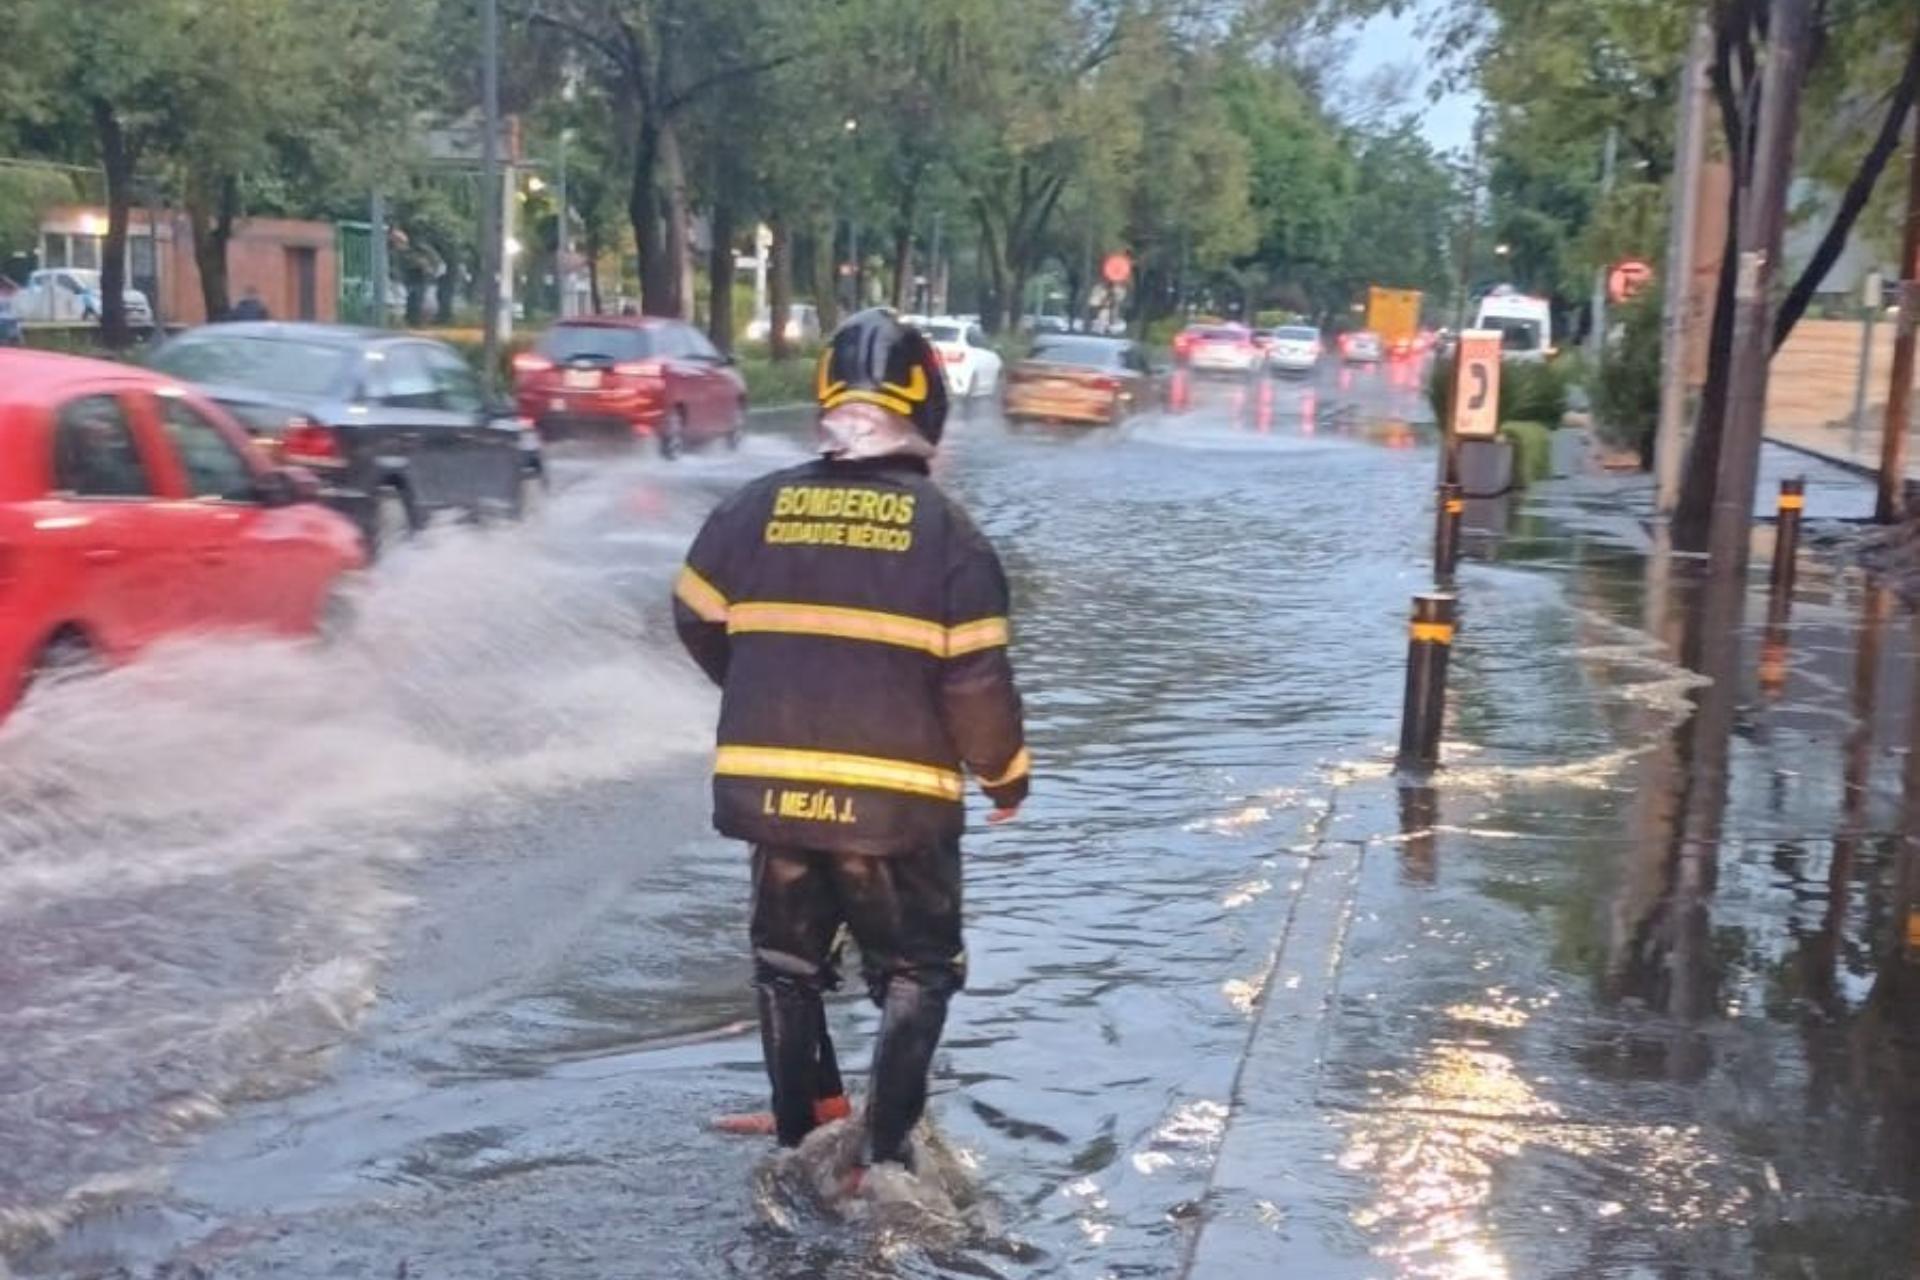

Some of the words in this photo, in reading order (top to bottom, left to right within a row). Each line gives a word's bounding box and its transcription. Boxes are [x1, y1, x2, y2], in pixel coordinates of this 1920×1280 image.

[774, 486, 915, 524] BOMBEROS
[766, 521, 820, 544] CIUDAD
[821, 522, 846, 545] DE
[846, 523, 911, 552] MÉXICO
[780, 789, 837, 820] MEJÍA
